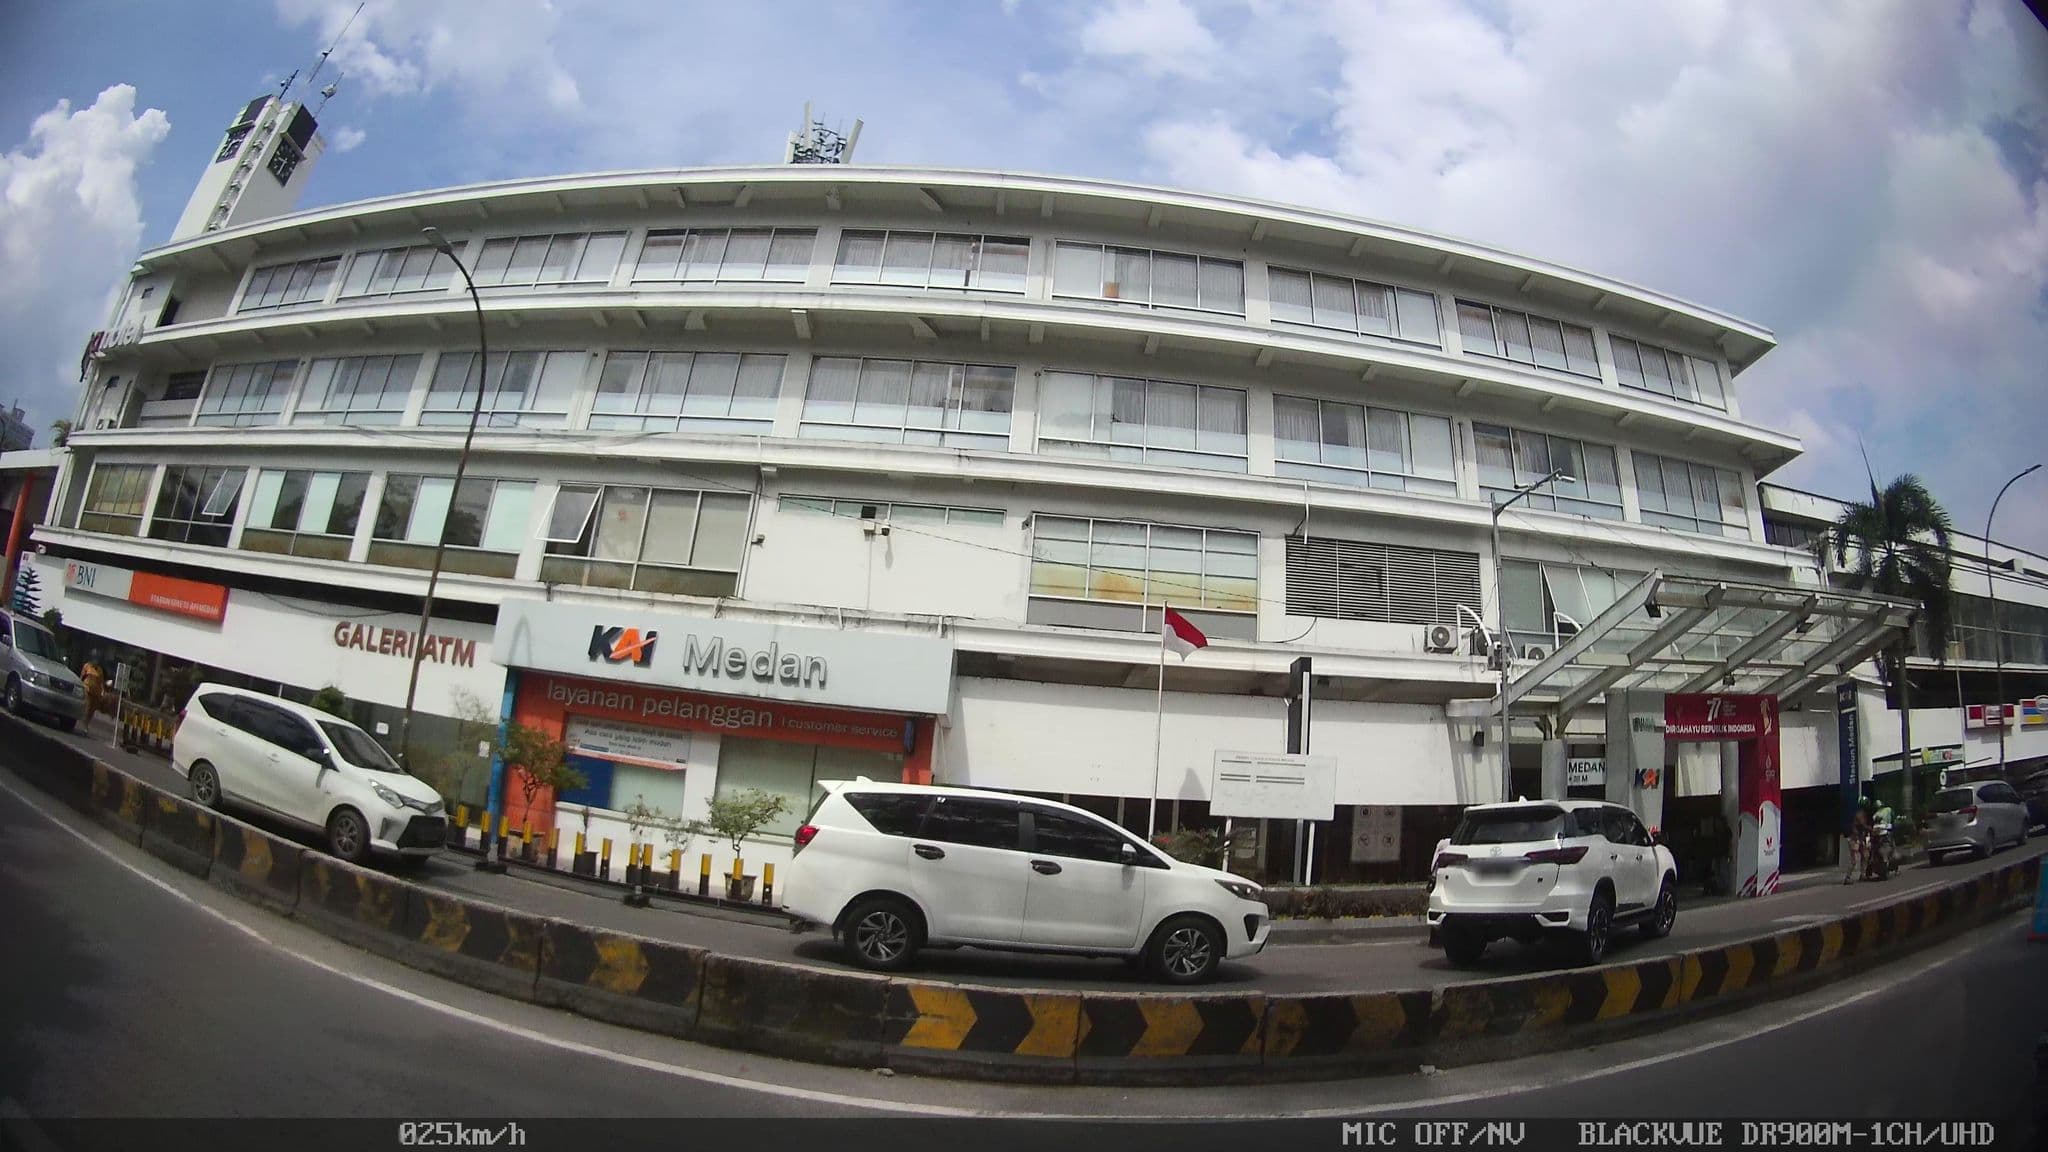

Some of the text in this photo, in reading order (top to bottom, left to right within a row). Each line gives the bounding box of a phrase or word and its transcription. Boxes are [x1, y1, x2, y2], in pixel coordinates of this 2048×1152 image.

[76, 565, 97, 588] BNI
[334, 621, 477, 668] GALERI ATM
[588, 624, 828, 687] KAI Medan
[548, 680, 634, 706] layanan
[642, 696, 773, 728] pelanggan
[788, 719, 848, 733] customer
[852, 726, 898, 738] service
[1568, 761, 1606, 773] MEDAN
